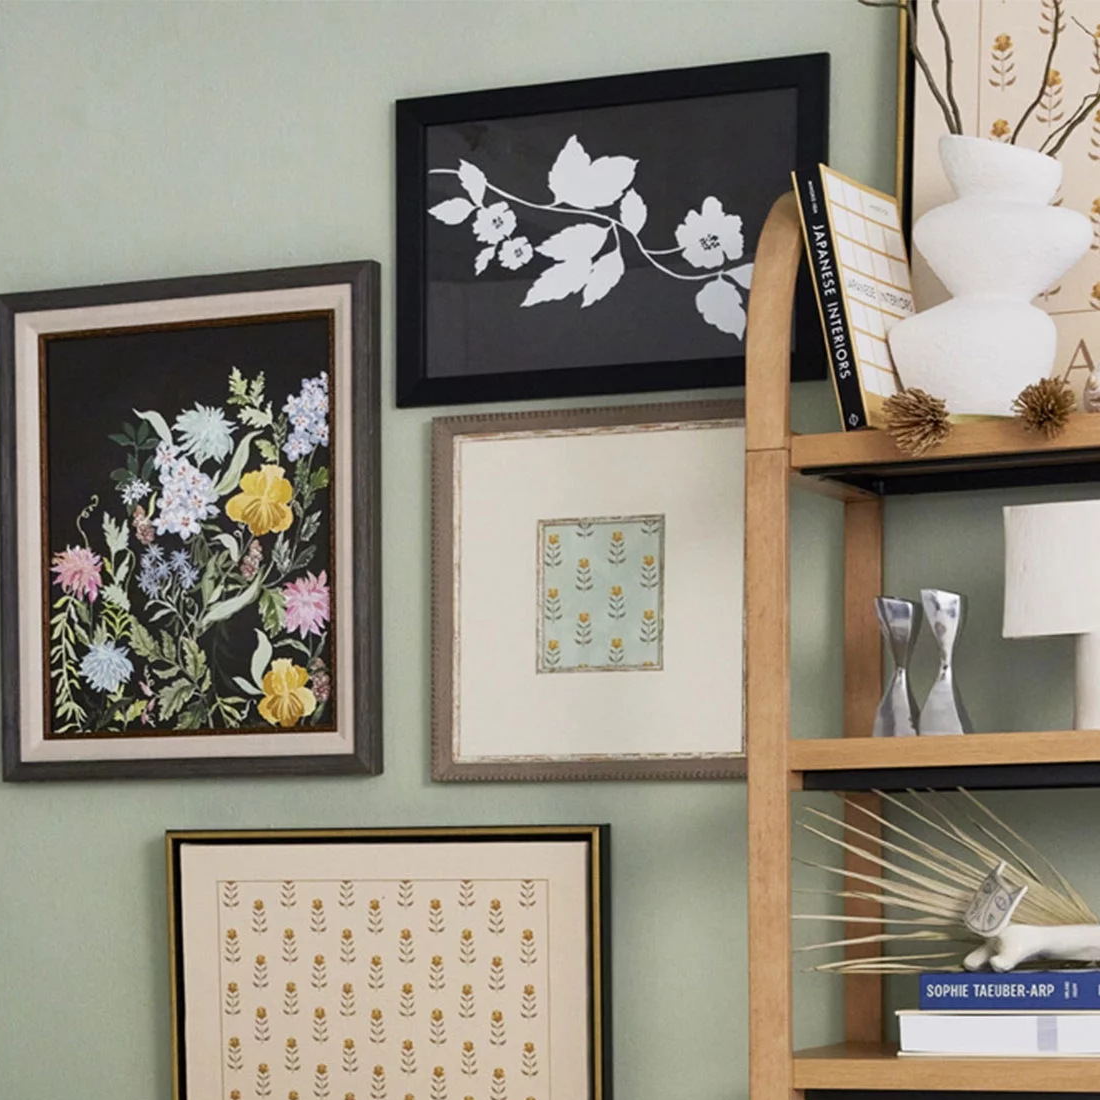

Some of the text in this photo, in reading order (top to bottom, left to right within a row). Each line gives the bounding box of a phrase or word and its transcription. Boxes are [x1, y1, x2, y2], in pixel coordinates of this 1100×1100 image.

[812, 225, 837, 296] JAPANESE
[827, 301, 851, 379] INTERIORS
[926, 984, 969, 998] SOPHIE
[973, 984, 1055, 998] TAEUBER-ARP
